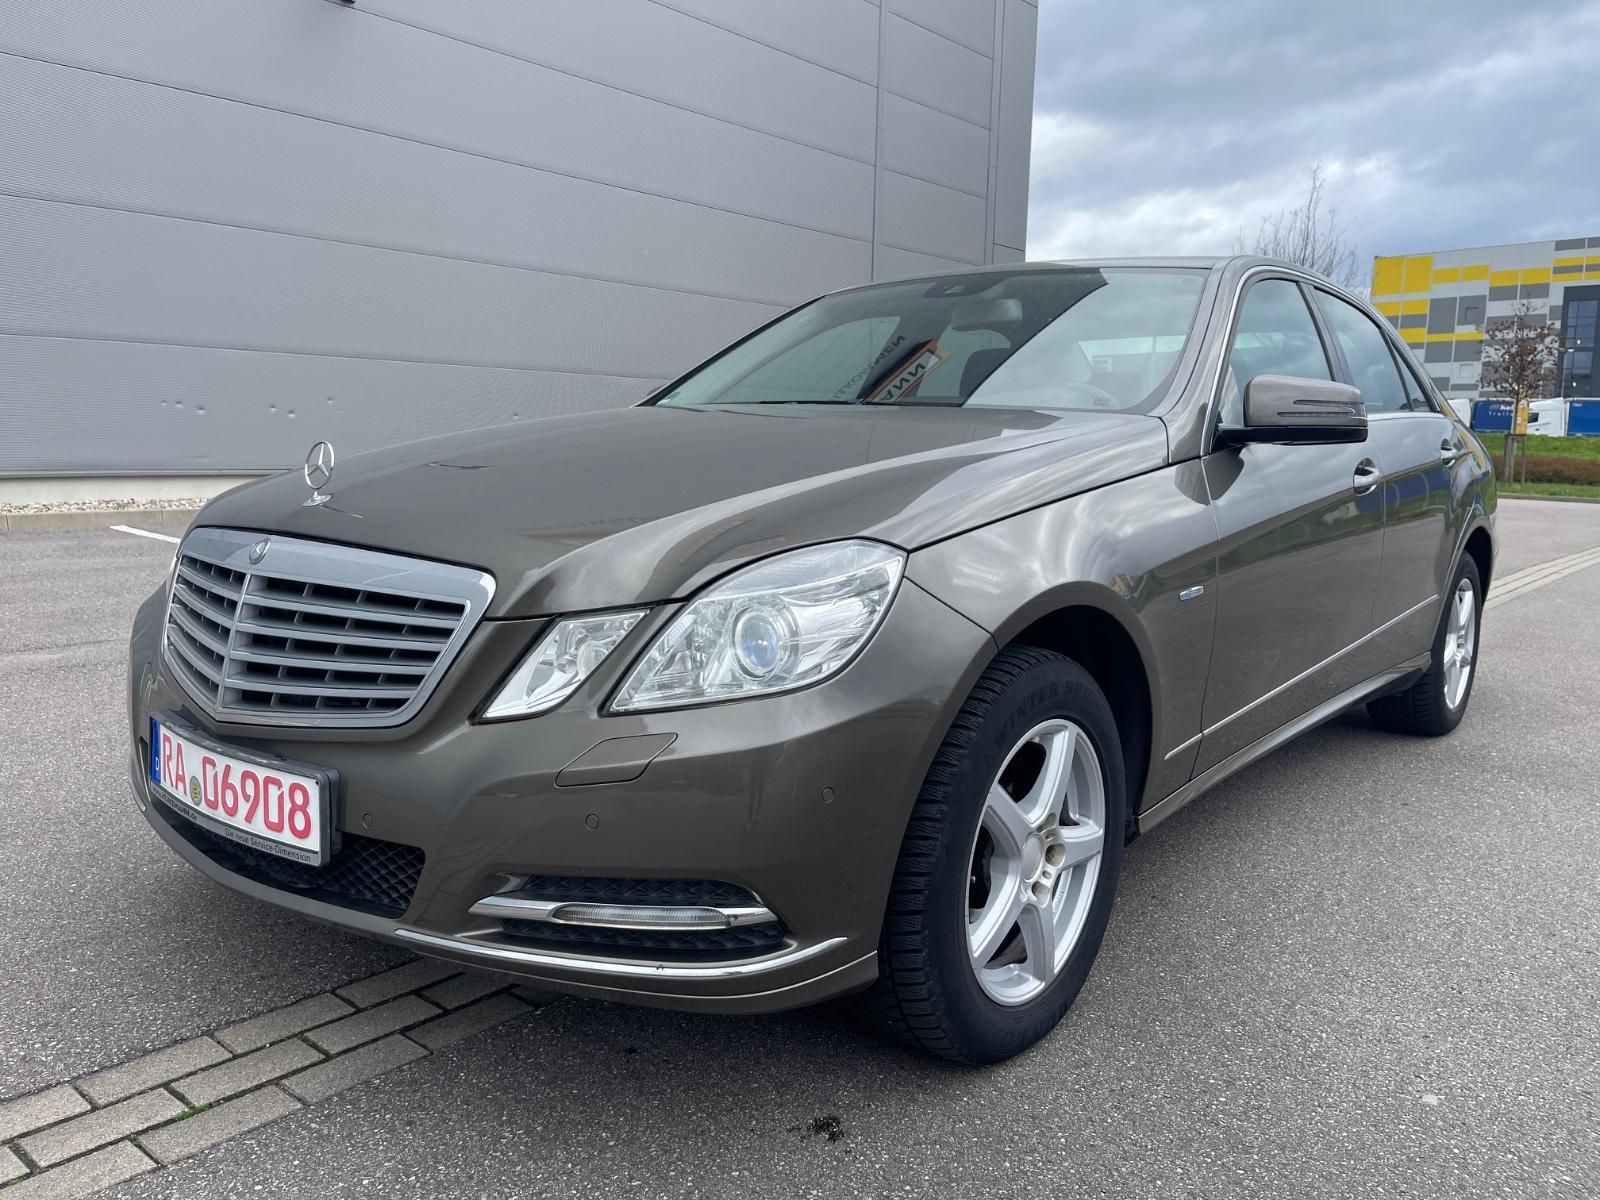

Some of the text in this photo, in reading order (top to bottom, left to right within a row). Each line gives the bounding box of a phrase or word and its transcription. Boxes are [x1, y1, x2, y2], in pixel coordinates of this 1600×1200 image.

[155, 757, 160, 770] D
[162, 733, 312, 839] RA 06908
[225, 827, 235, 838] Die
[250, 836, 311, 863] Service-Dimension
